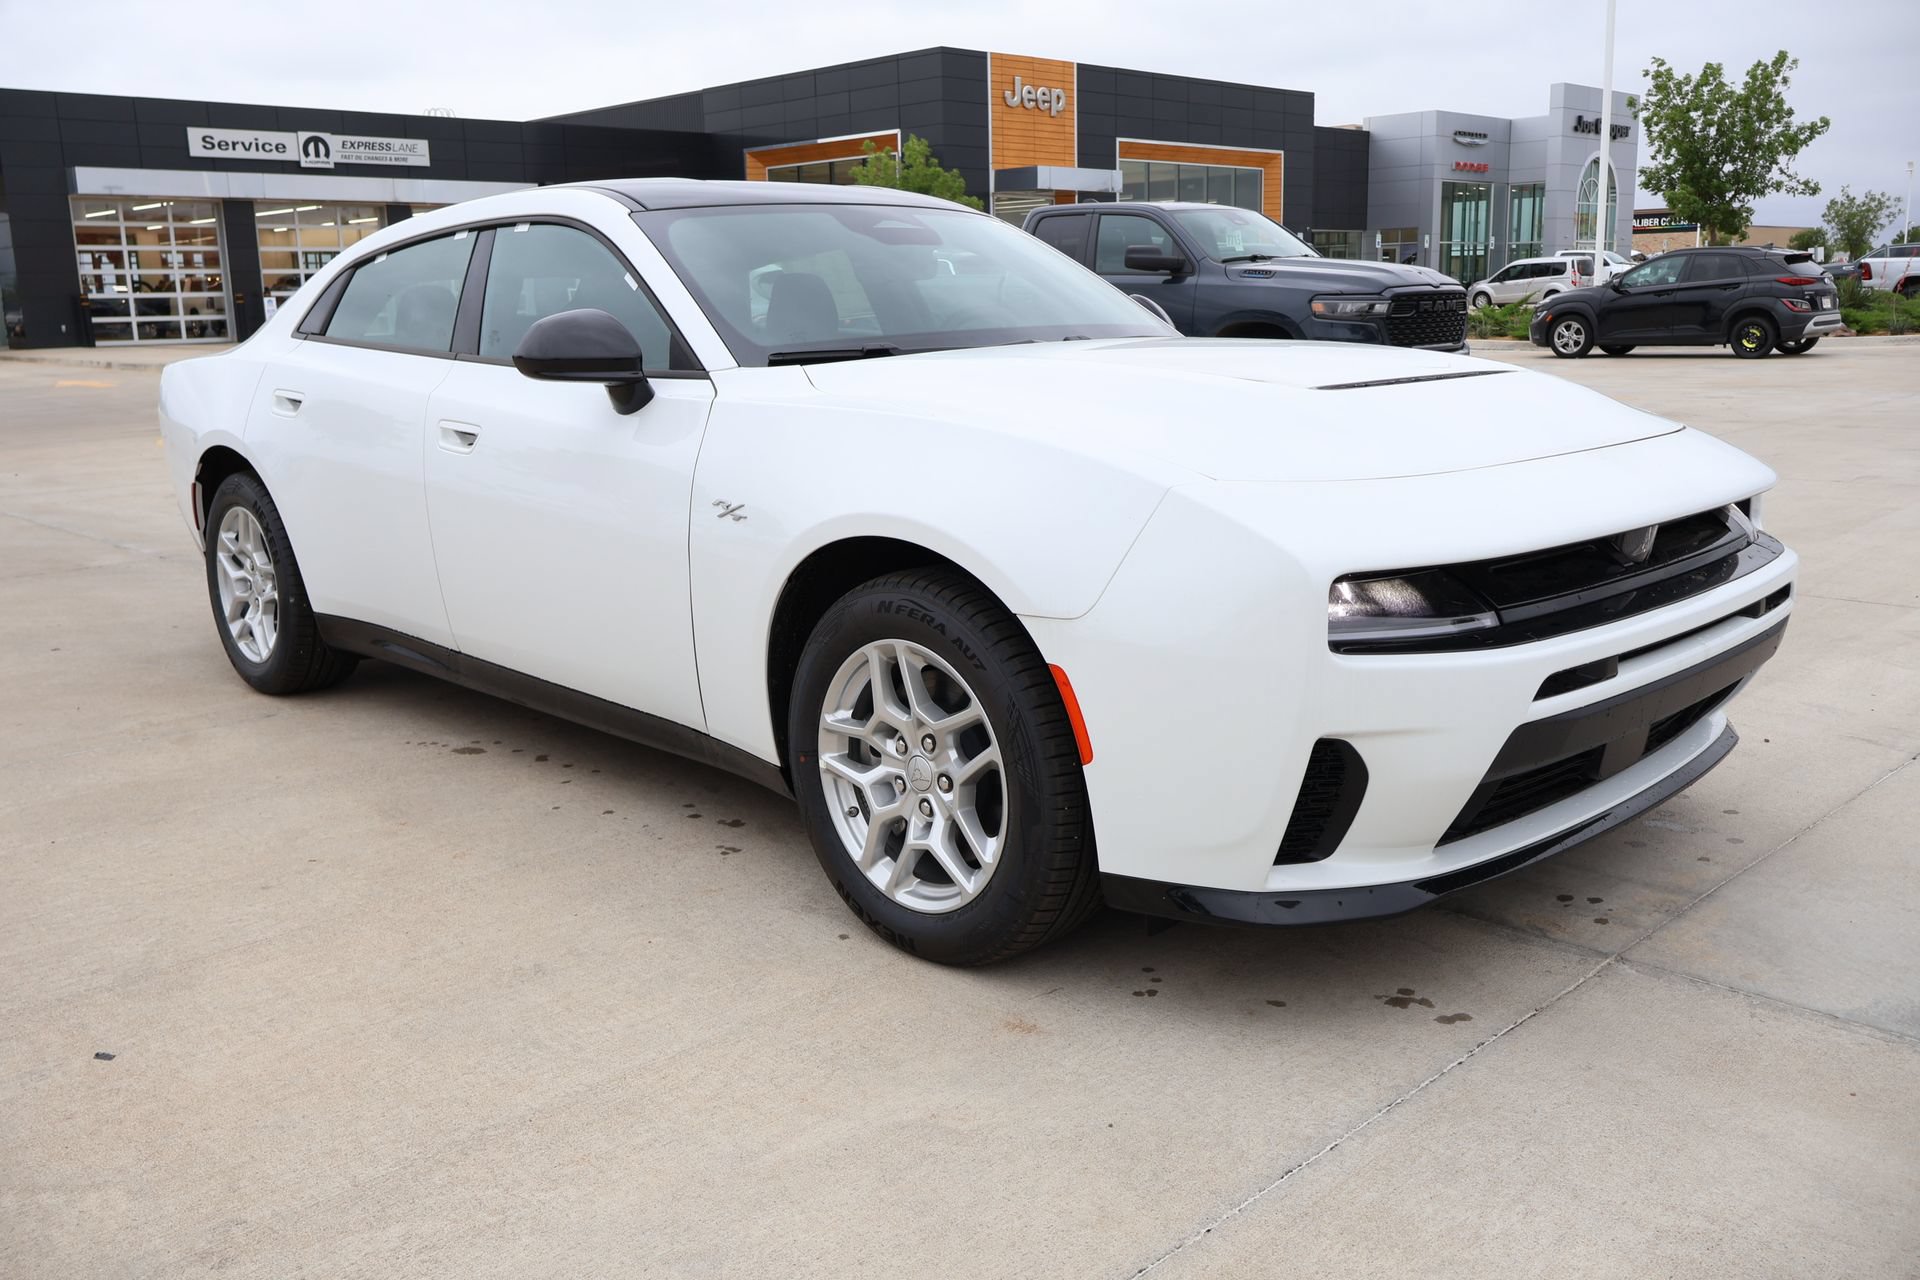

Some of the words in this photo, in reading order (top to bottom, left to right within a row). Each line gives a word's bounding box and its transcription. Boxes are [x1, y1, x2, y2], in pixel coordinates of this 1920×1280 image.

[1004, 75, 1066, 117] Jeep
[201, 135, 287, 153] Service
[1632, 218, 1660, 227] ALIBER
[1419, 300, 1457, 313] RAM
[951, 636, 987, 671] AU7
